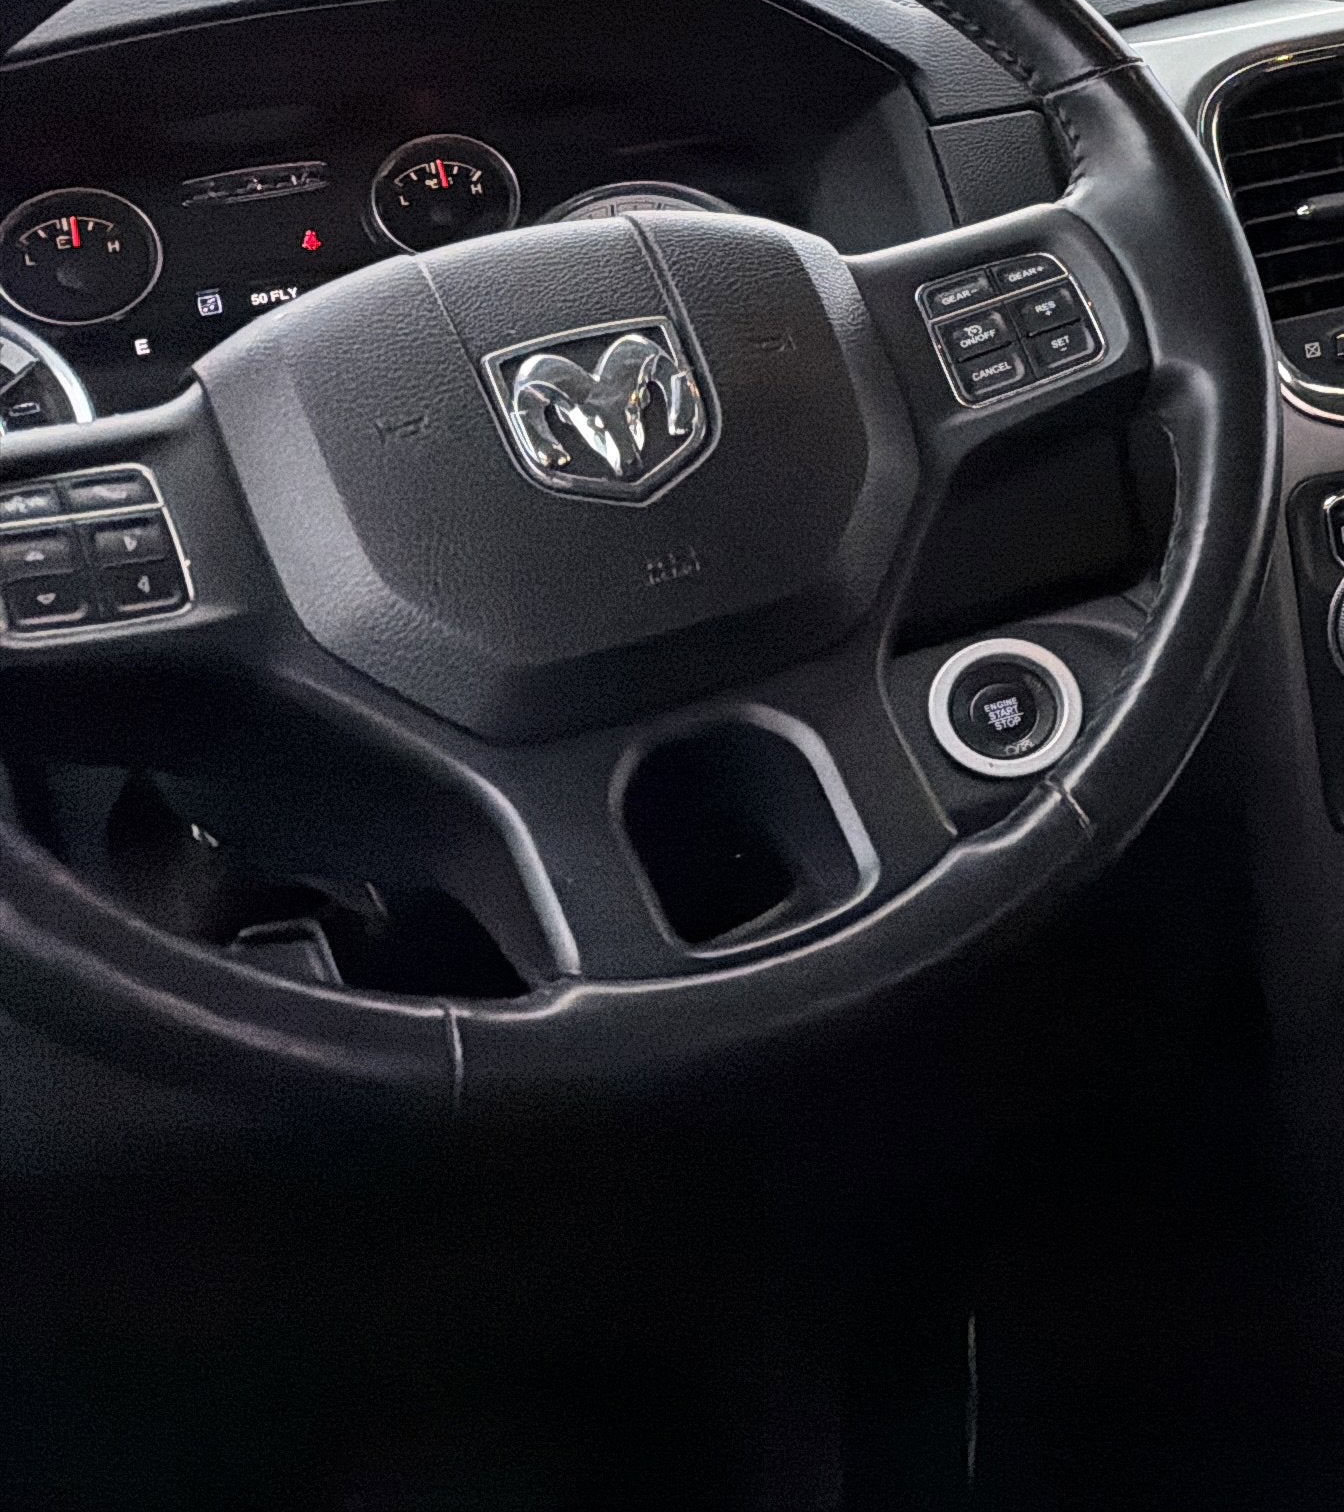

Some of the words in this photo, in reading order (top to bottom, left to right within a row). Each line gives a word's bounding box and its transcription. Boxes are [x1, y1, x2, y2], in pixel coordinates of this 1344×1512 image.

[470, 182, 483, 194] H
[400, 195, 410, 206] L
[107, 239, 120, 253] H
[25, 252, 36, 266] L
[250, 291, 269, 307] 50
[269, 287, 298, 303] FLY
[1034, 300, 1057, 314] RES
[135, 338, 150, 356] E
[959, 328, 997, 349] ON/OFF
[1050, 335, 1071, 350] SET
[971, 361, 1013, 382] CANCEL
[983, 696, 1018, 713] ENGINE
[988, 704, 1020, 722] START
[993, 714, 1022, 731] STOP
